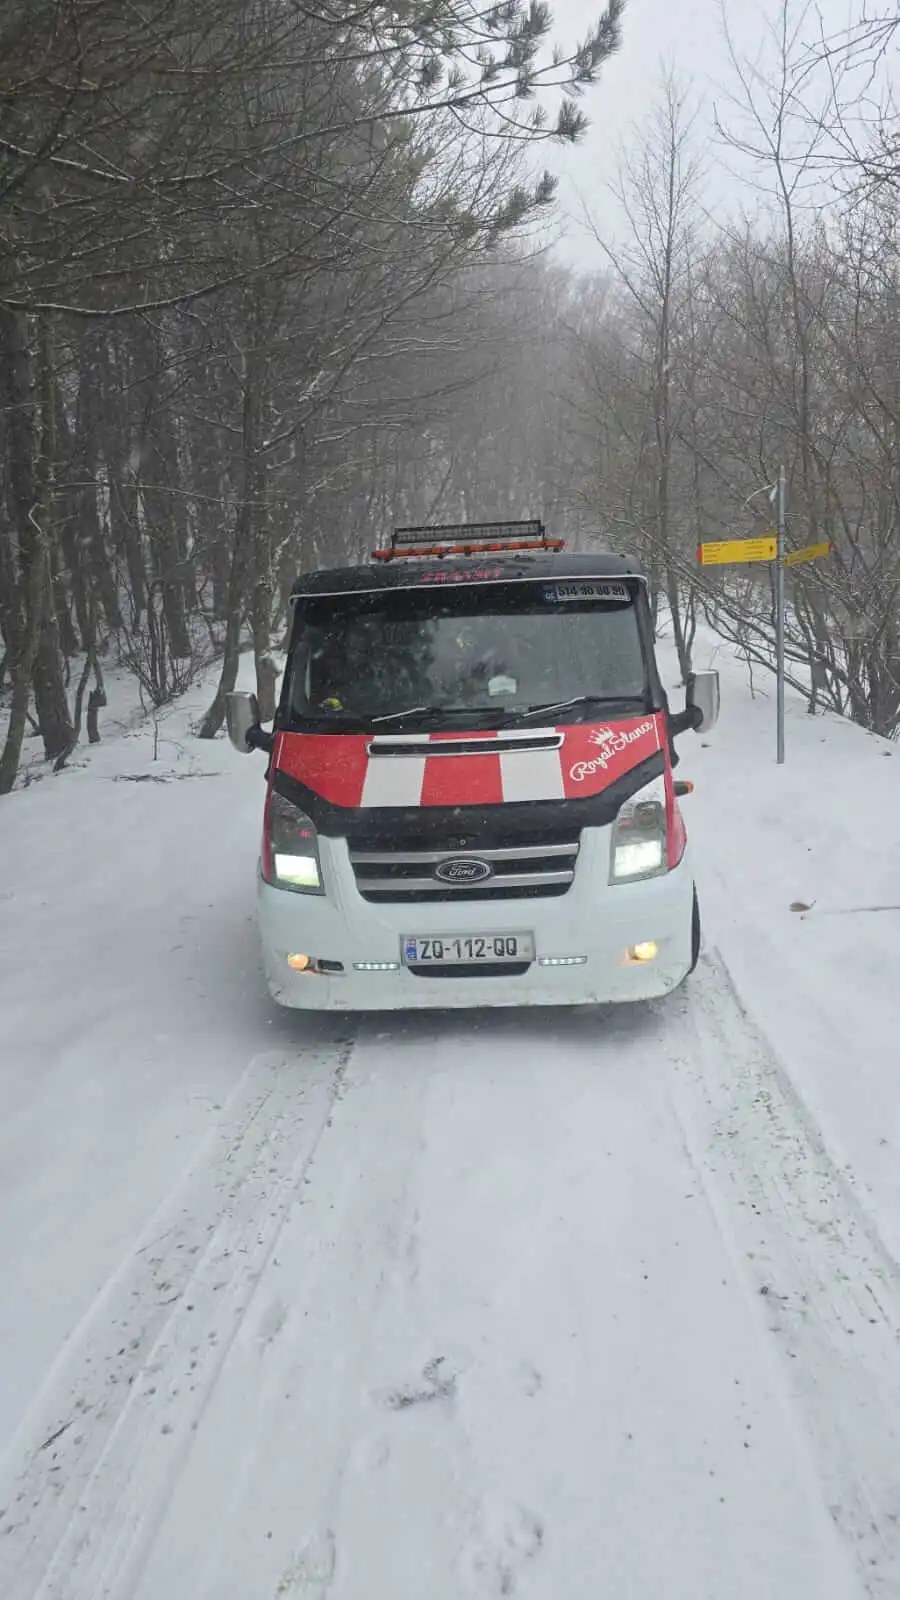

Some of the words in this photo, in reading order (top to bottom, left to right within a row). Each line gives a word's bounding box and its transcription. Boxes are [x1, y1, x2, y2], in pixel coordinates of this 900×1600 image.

[570, 743, 615, 781] Royal
[449, 864, 476, 876] Ford
[420, 937, 518, 960] ZQ-112-QQ
